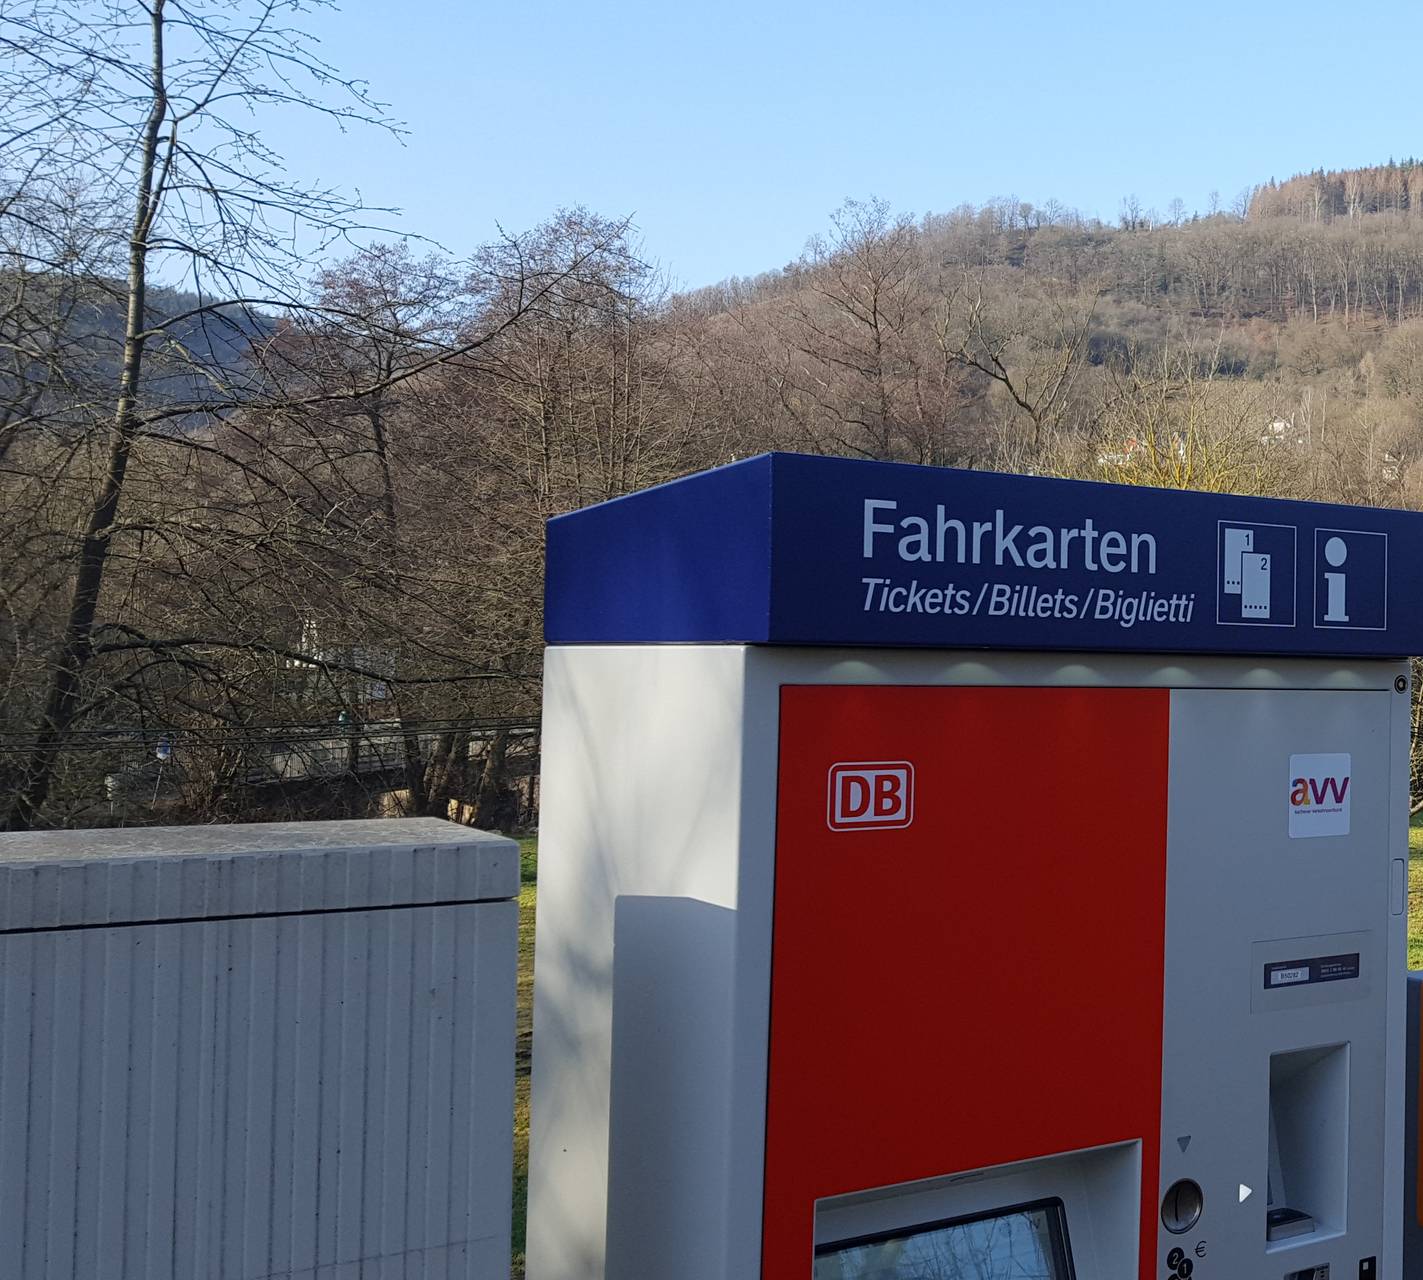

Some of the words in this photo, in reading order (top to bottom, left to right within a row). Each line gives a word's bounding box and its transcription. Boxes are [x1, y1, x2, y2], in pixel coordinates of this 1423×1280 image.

[863, 498, 1157, 575] Fahrkarten
[1244, 533, 1252, 547] 1
[1260, 556, 1269, 571] 2
[840, 773, 902, 819] DB
[1291, 776, 1350, 806] avv
[1172, 1252, 1180, 1265] 2
[1182, 1263, 1187, 1274] 1
